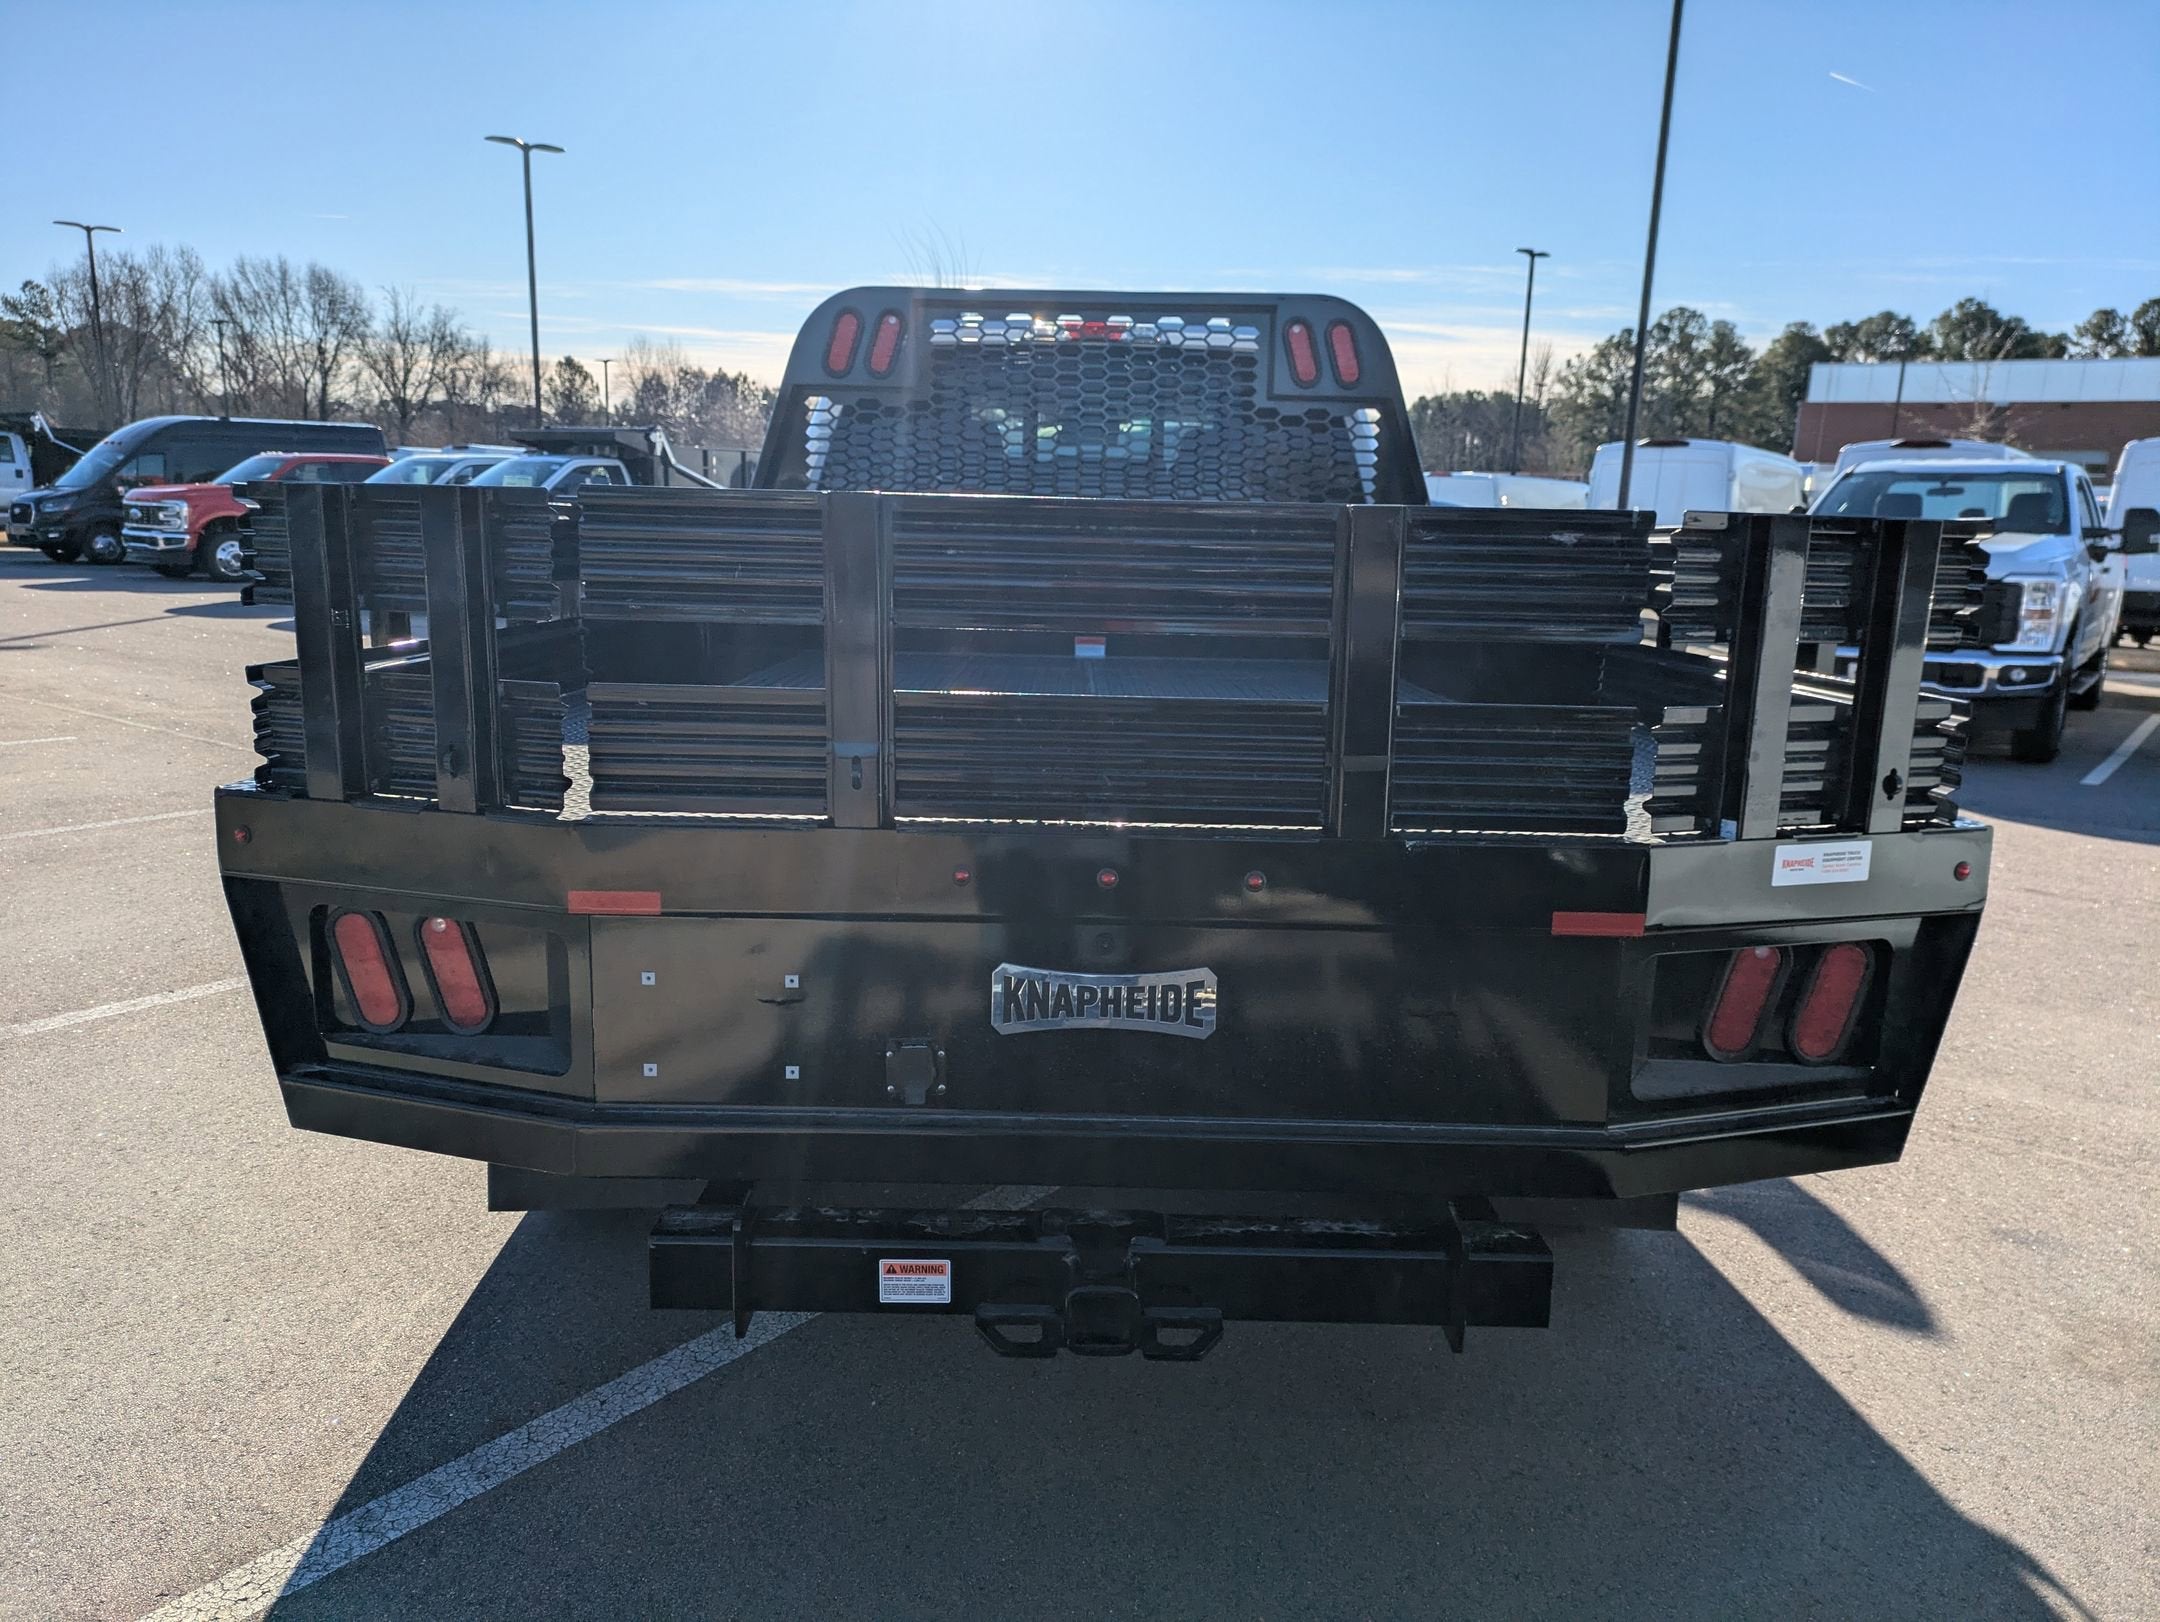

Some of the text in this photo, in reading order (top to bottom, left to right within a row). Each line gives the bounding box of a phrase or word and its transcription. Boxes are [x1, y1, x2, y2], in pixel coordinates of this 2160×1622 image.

[1781, 857, 1815, 869] KNAPHEIDE
[1002, 975, 1206, 1029] KNAPHEIDE
[900, 1264, 944, 1274] WARNING
